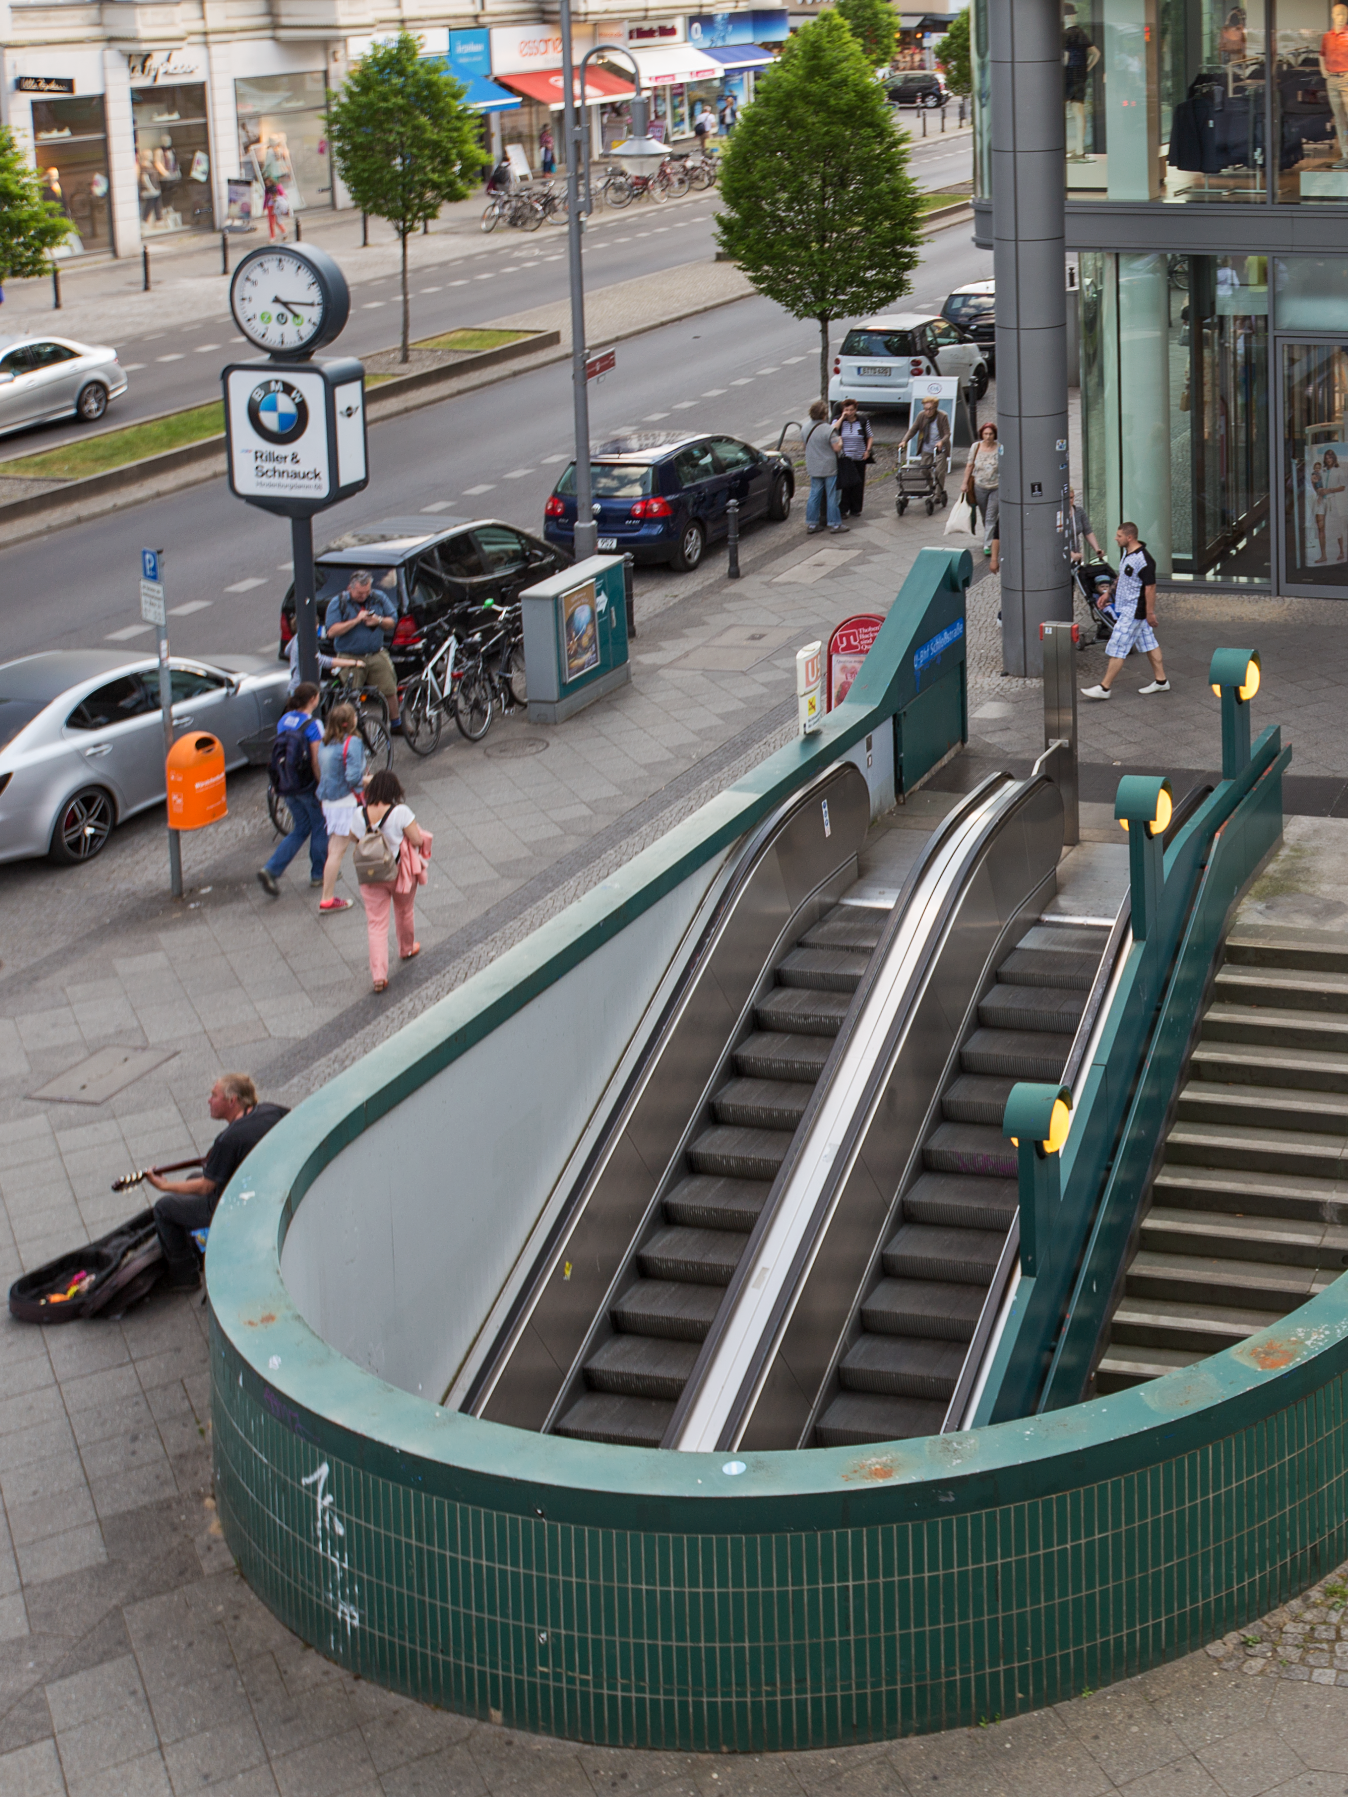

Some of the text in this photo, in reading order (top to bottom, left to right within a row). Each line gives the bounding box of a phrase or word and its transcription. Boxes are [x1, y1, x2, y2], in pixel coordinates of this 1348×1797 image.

[252, 380, 304, 404] BMW
[254, 450, 301, 465] Riller &
[254, 465, 323, 481] Schnauck
[145, 552, 155, 576] P
